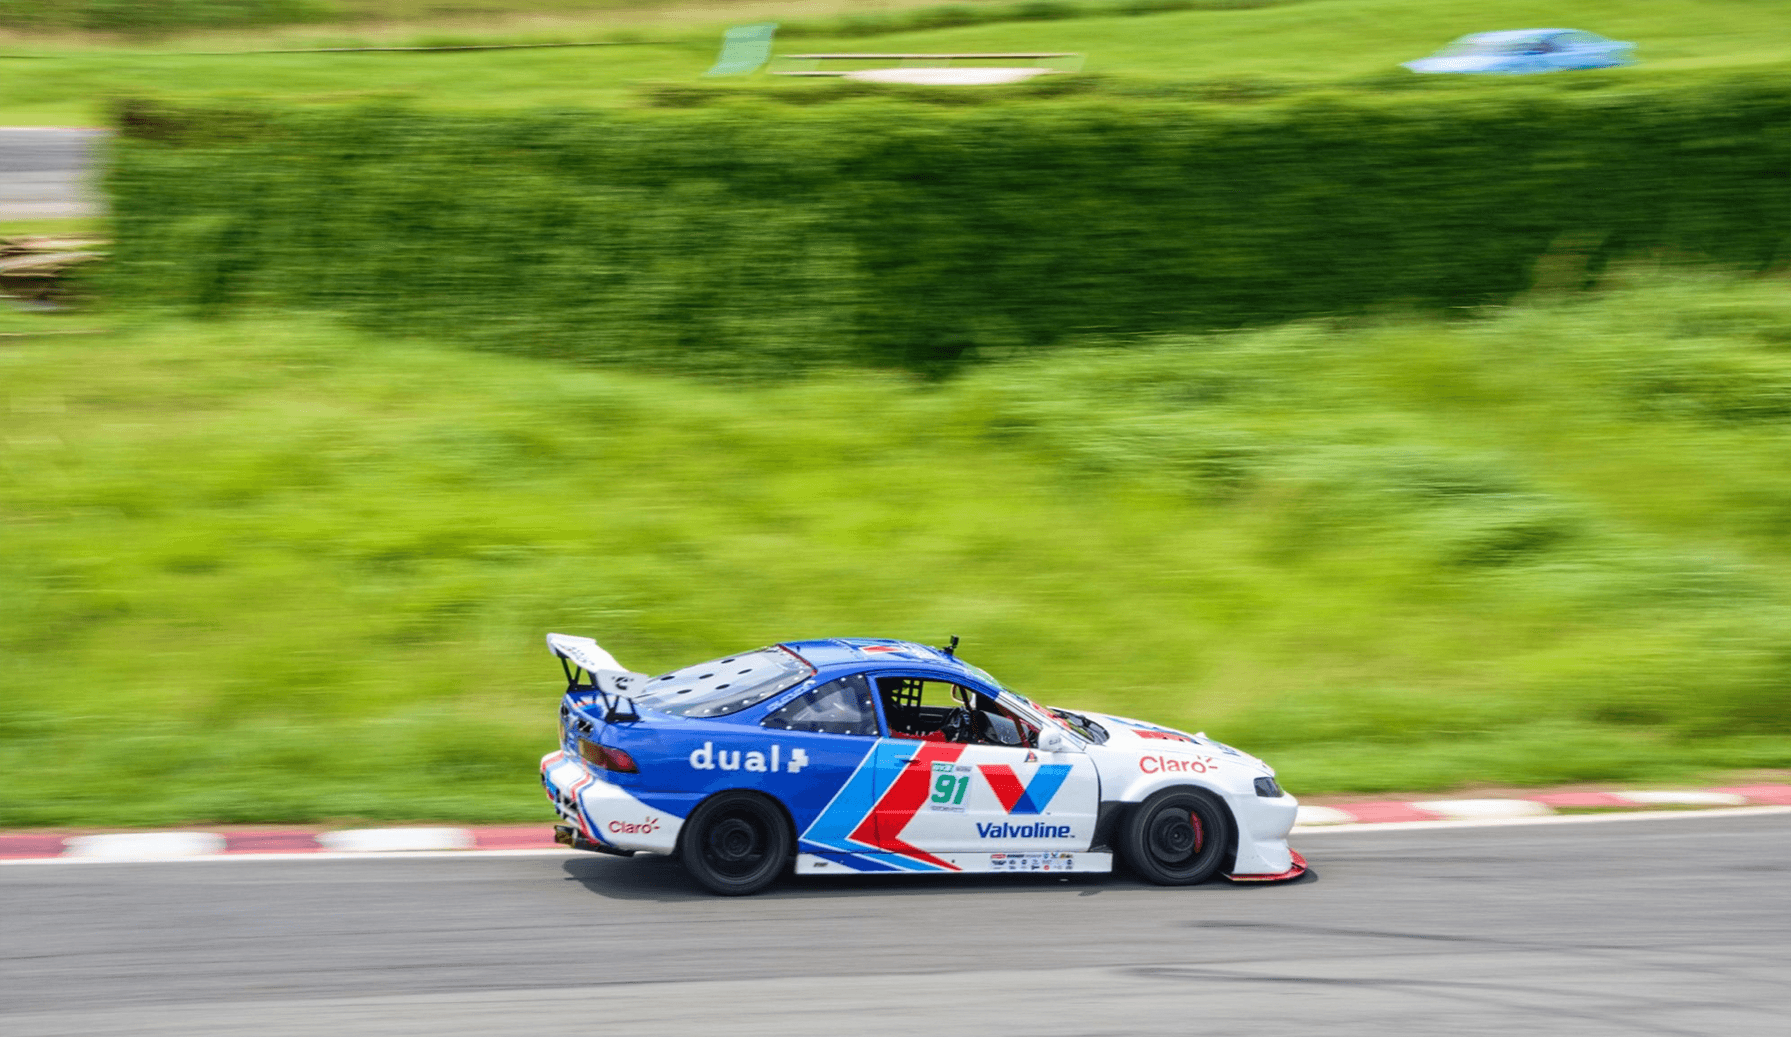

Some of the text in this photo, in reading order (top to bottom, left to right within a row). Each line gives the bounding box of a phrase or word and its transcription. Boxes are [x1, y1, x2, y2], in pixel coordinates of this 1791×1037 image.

[689, 741, 780, 772] dual
[1139, 755, 1209, 774] Claro
[931, 774, 970, 805] 91
[608, 819, 653, 834] Claro
[976, 822, 1072, 839] Valvoline
